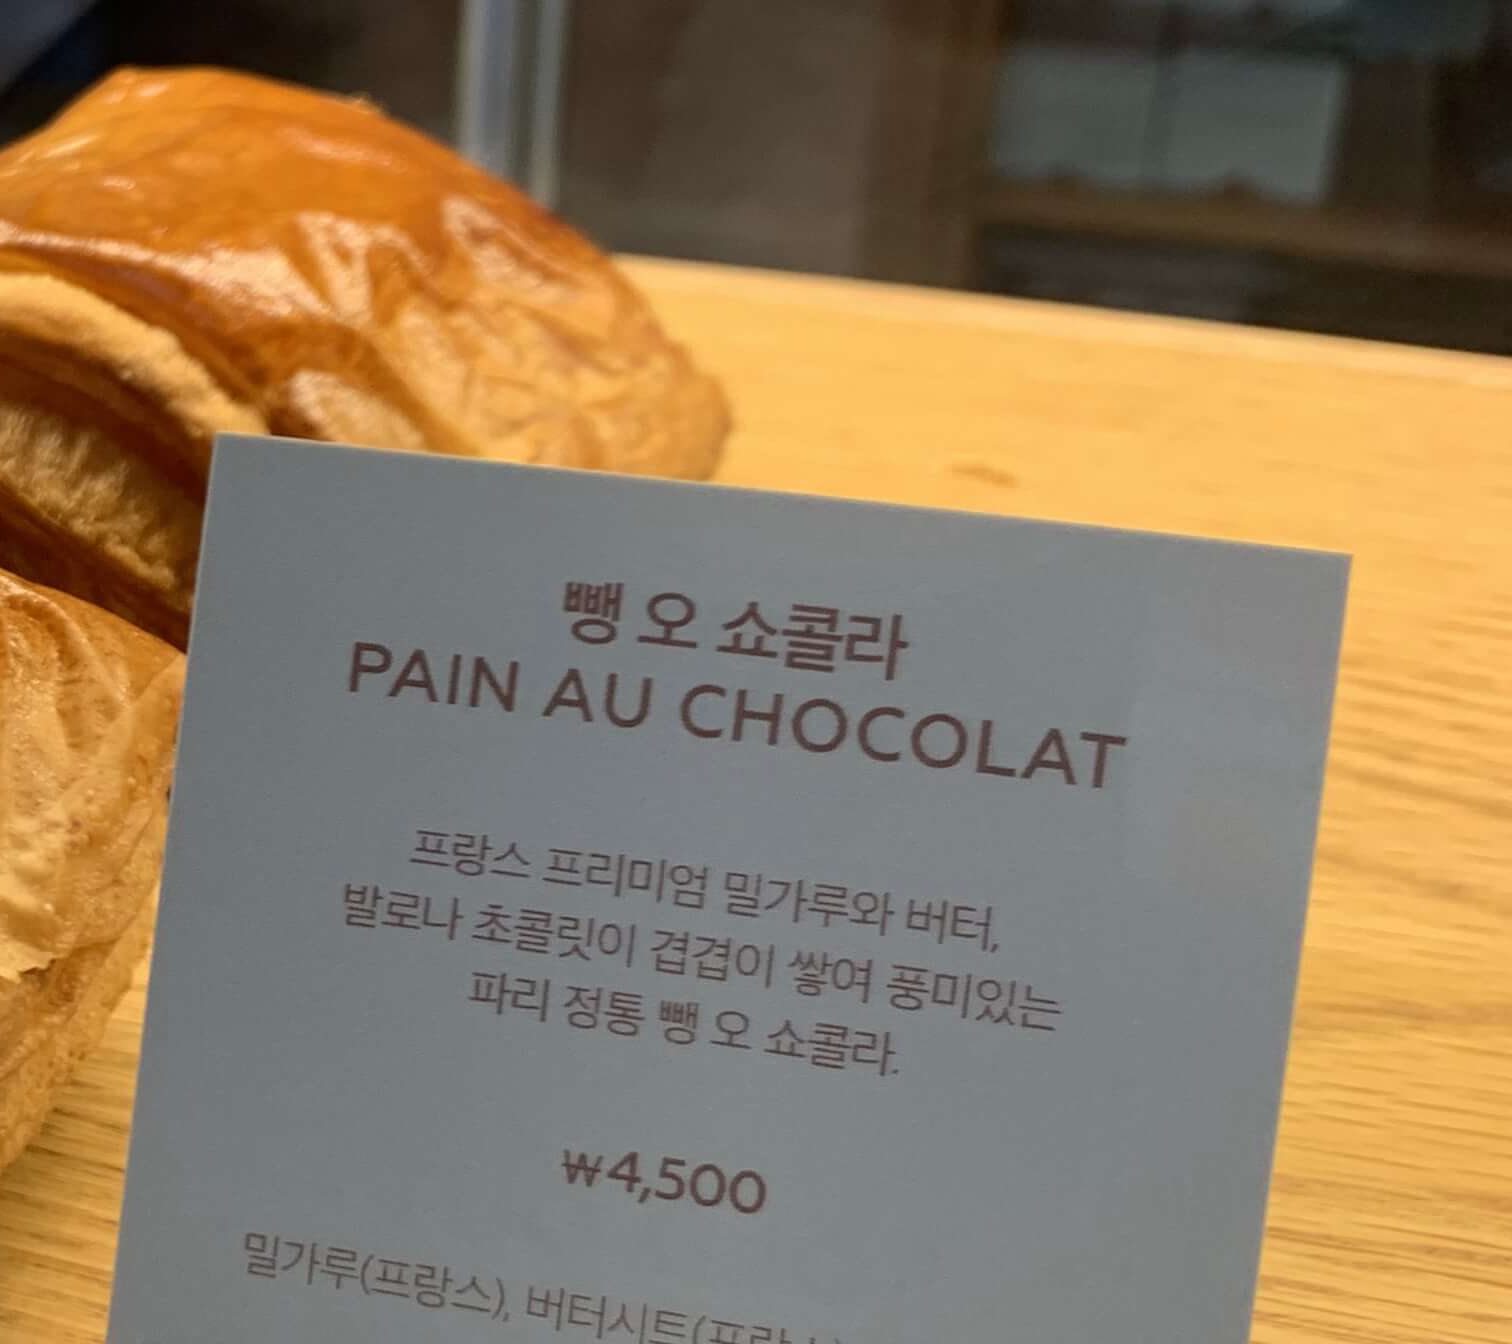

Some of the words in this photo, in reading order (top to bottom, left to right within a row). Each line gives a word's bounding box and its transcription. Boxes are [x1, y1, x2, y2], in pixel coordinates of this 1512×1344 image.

[562, 581, 624, 645] 뺑
[636, 592, 698, 649] 오
[715, 601, 910, 681] 쇼콜라
[348, 642, 520, 712] PAIN
[541, 668, 653, 728] AU
[679, 684, 1128, 789] CHOCOLAT
[409, 830, 531, 878] 프랑스
[542, 849, 709, 909] 프리미엄
[724, 872, 895, 936] 밀가루와
[906, 899, 1000, 953] 버터,
[344, 883, 464, 940] 발로나
[472, 904, 636, 968] 초콜릿이
[650, 930, 775, 989] 겹겹이
[787, 951, 873, 1003] 쌓여
[886, 965, 1063, 1031] 풍미있는
[468, 972, 550, 1022] 파리
[563, 986, 646, 1037] 정통
[658, 1000, 699, 1045] 뺑
[709, 1011, 752, 1050] 오
[763, 1020, 899, 1077] 쇼콜라.
[561, 1149, 767, 1214] ₩4,500
[244, 1233, 509, 1322] 밀가루(프랑스),
